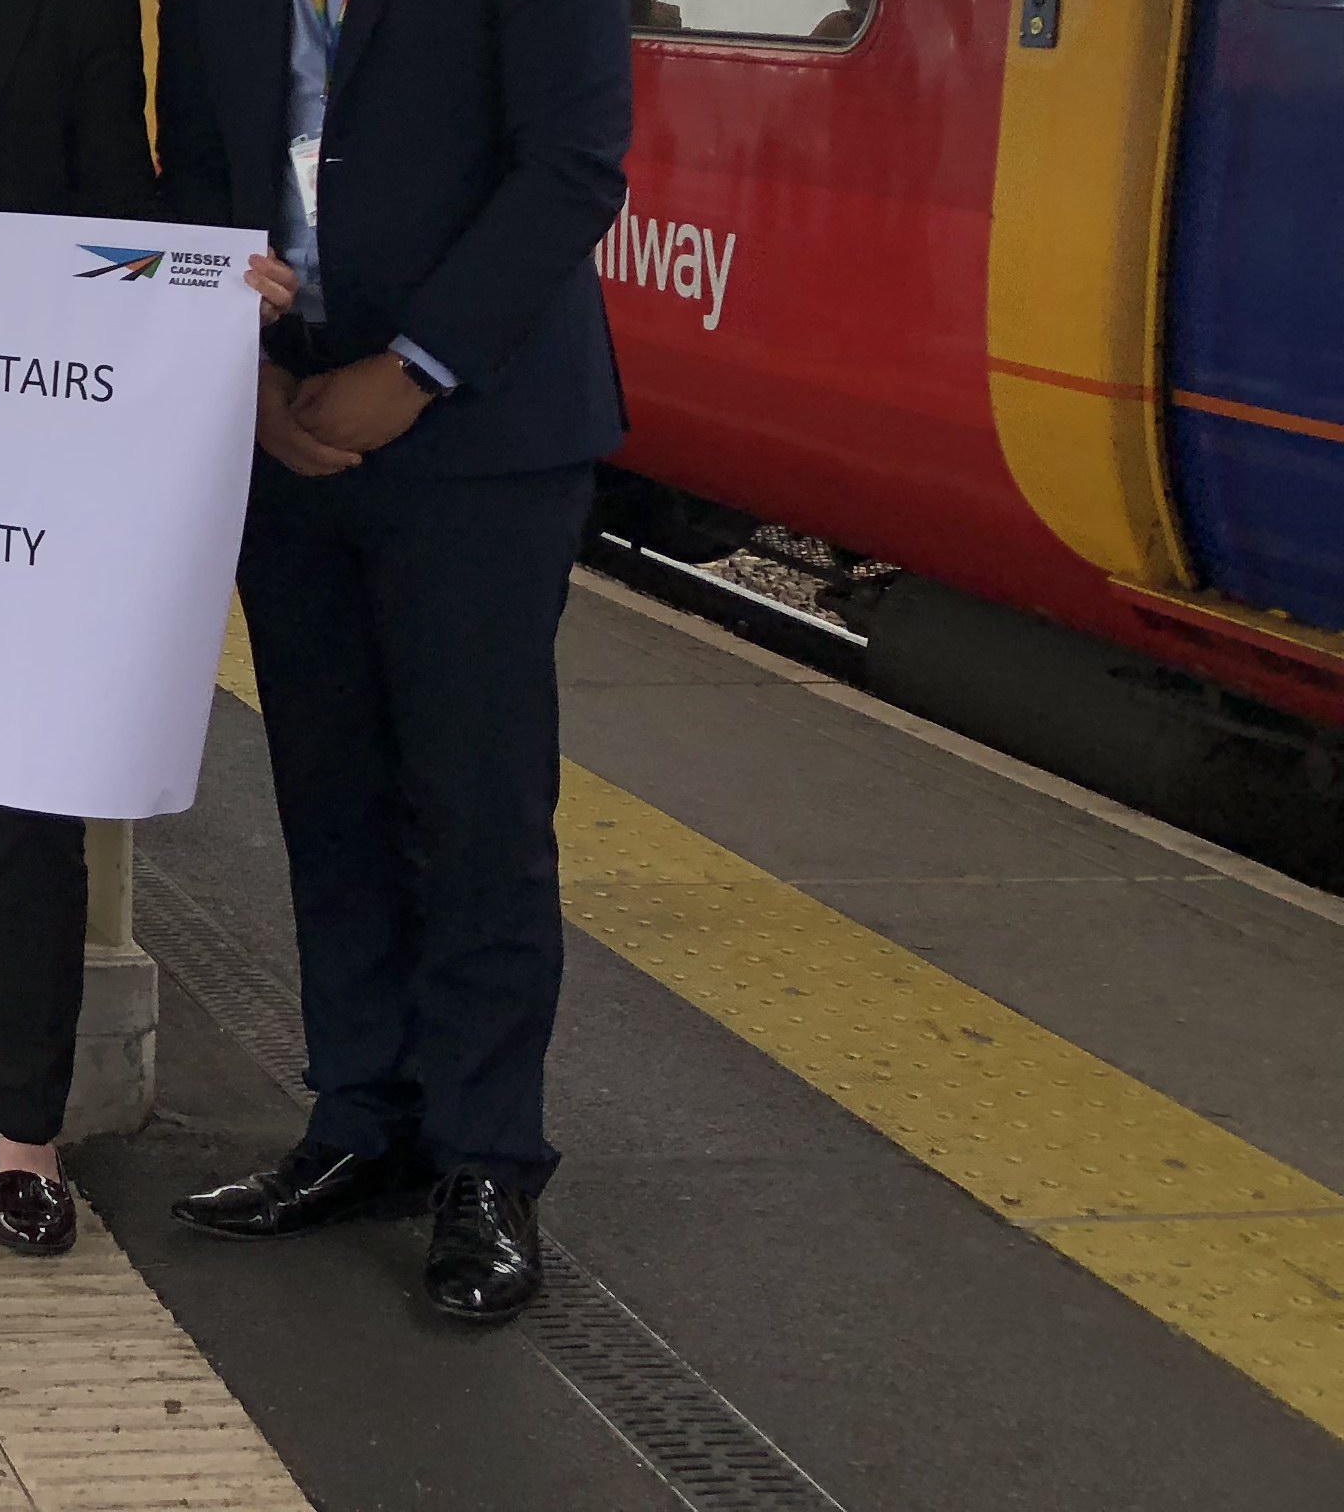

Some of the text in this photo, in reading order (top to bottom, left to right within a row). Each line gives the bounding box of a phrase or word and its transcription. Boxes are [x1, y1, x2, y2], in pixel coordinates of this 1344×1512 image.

[171, 251, 231, 267] WESSEX
[594, 186, 737, 332] ilway
[170, 265, 223, 278] CAPACITY
[168, 277, 220, 289] ALLIANCE
